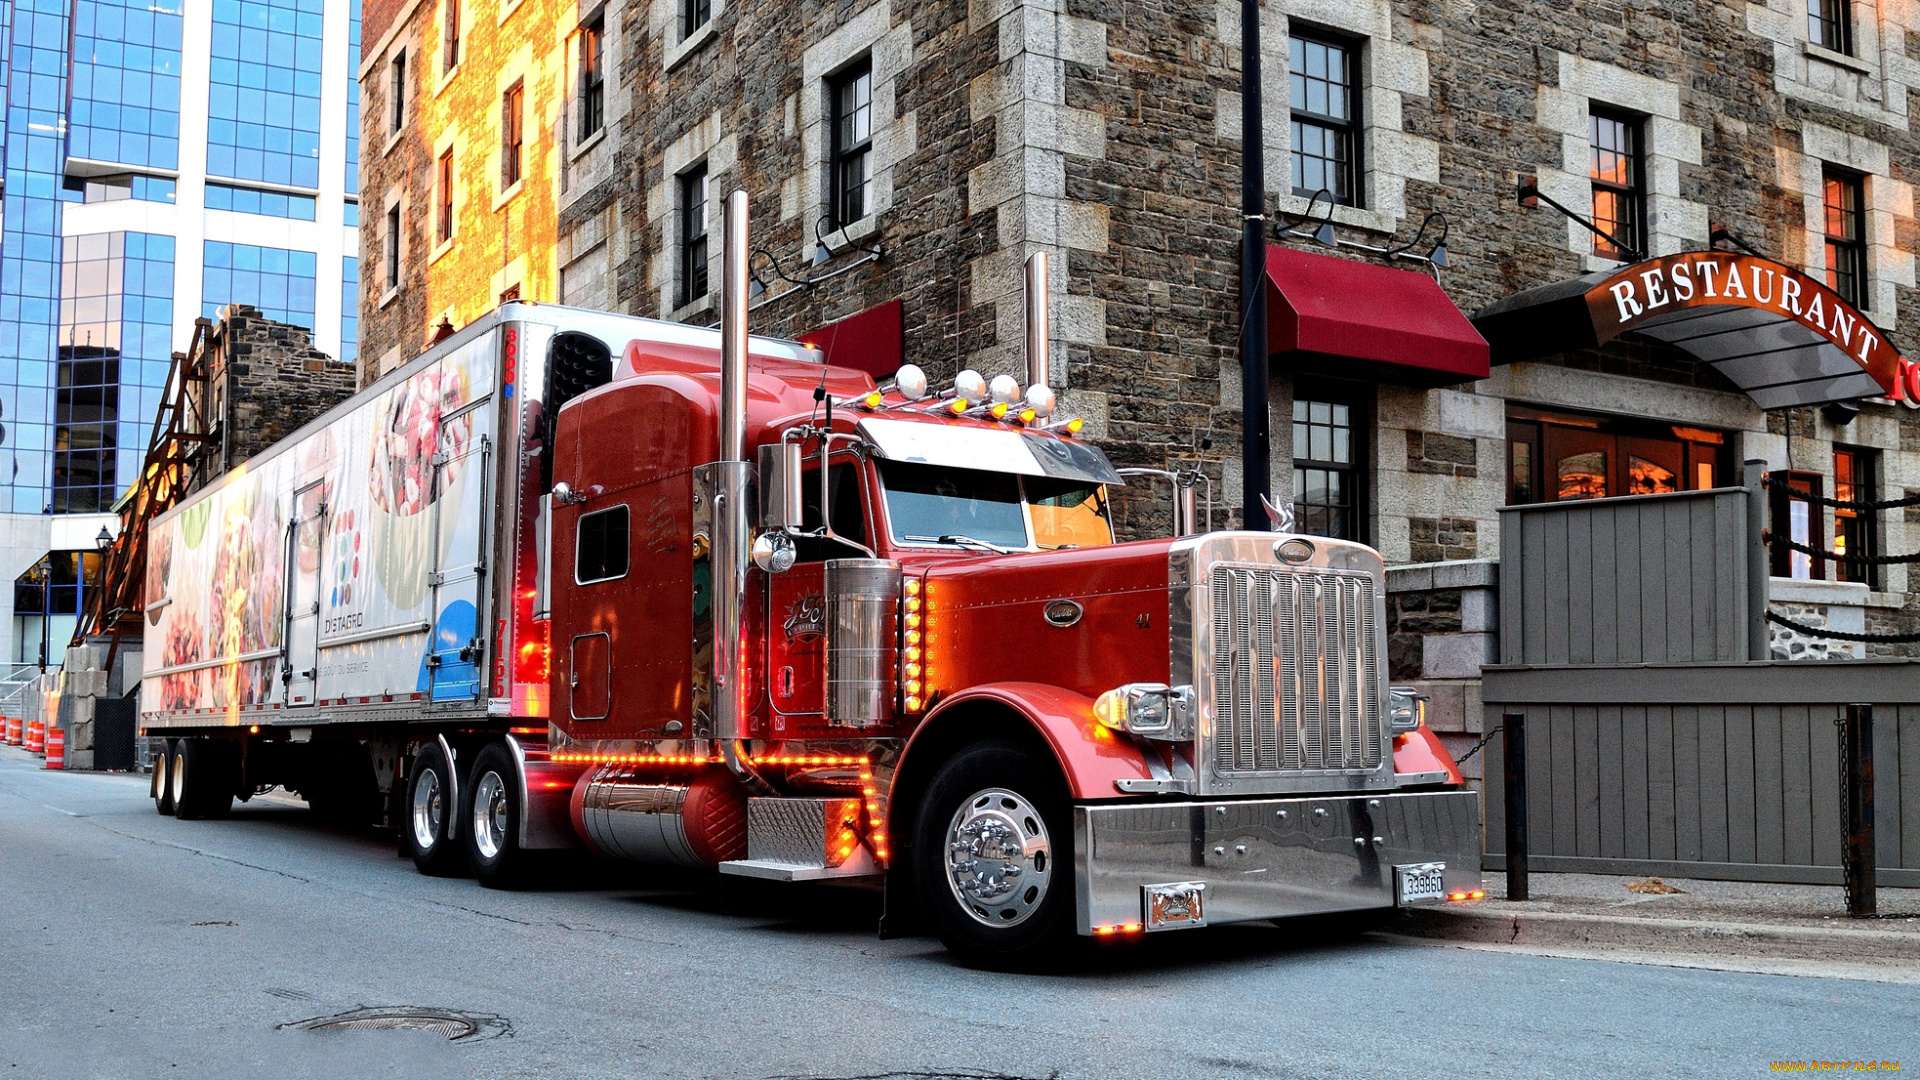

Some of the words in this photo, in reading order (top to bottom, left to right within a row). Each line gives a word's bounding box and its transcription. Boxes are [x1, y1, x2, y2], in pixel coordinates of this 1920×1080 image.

[1609, 260, 1878, 364] RESTAURANT
[346, 661, 368, 674] SERVICE
[493, 618, 507, 698] 7155
